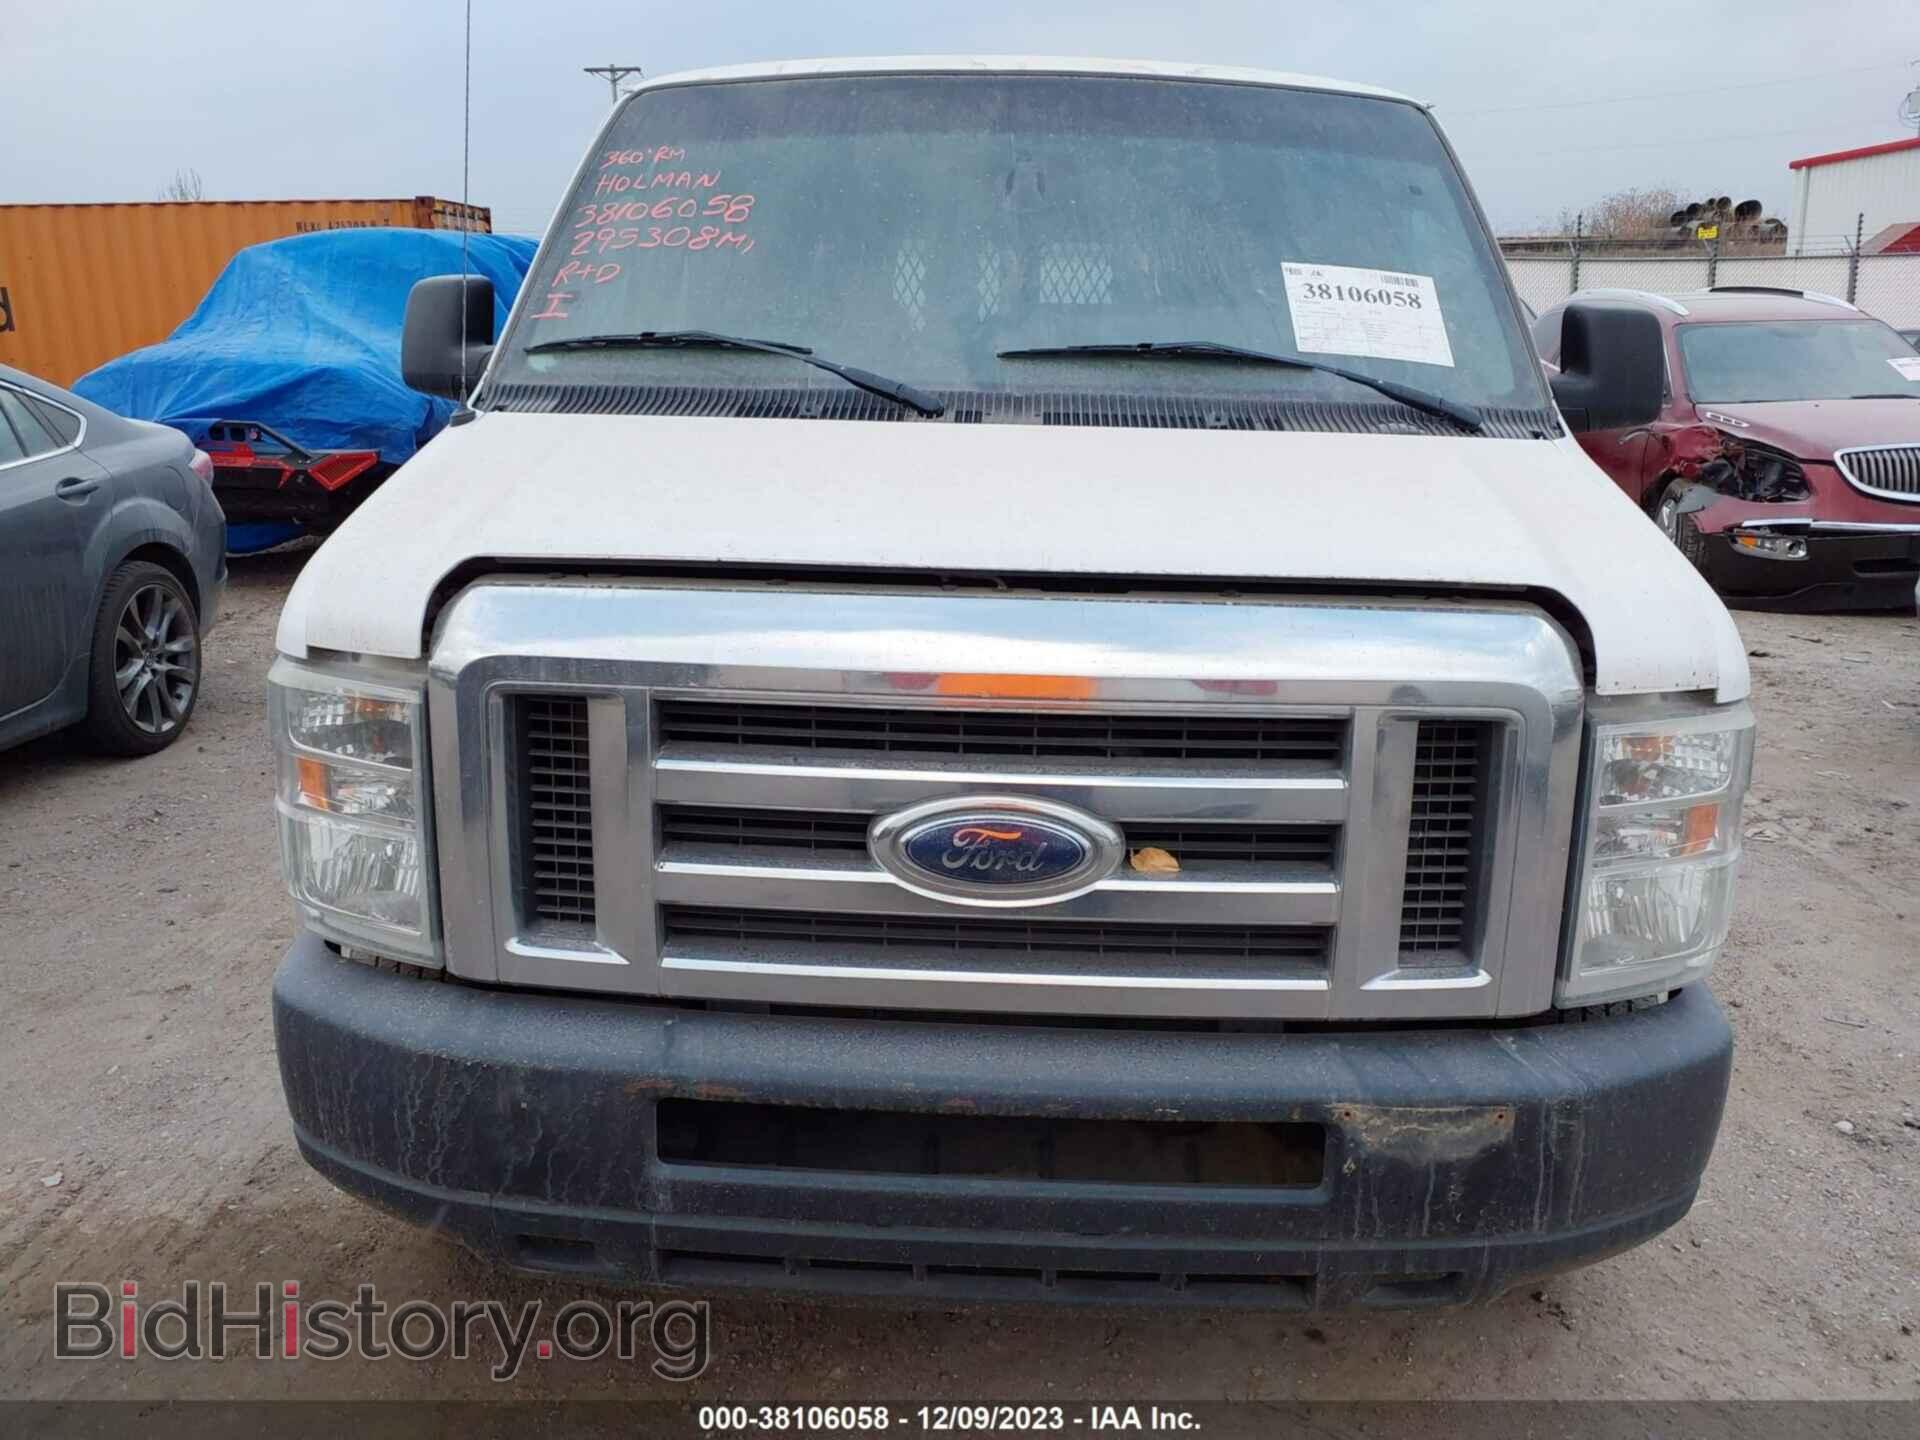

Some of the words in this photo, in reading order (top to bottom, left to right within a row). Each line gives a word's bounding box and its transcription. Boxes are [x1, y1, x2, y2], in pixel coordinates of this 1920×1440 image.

[595, 171, 720, 195] HOLMAN
[575, 194, 755, 228] 38106058
[1303, 282, 1423, 310] 38106058
[942, 828, 1049, 872] Ford
